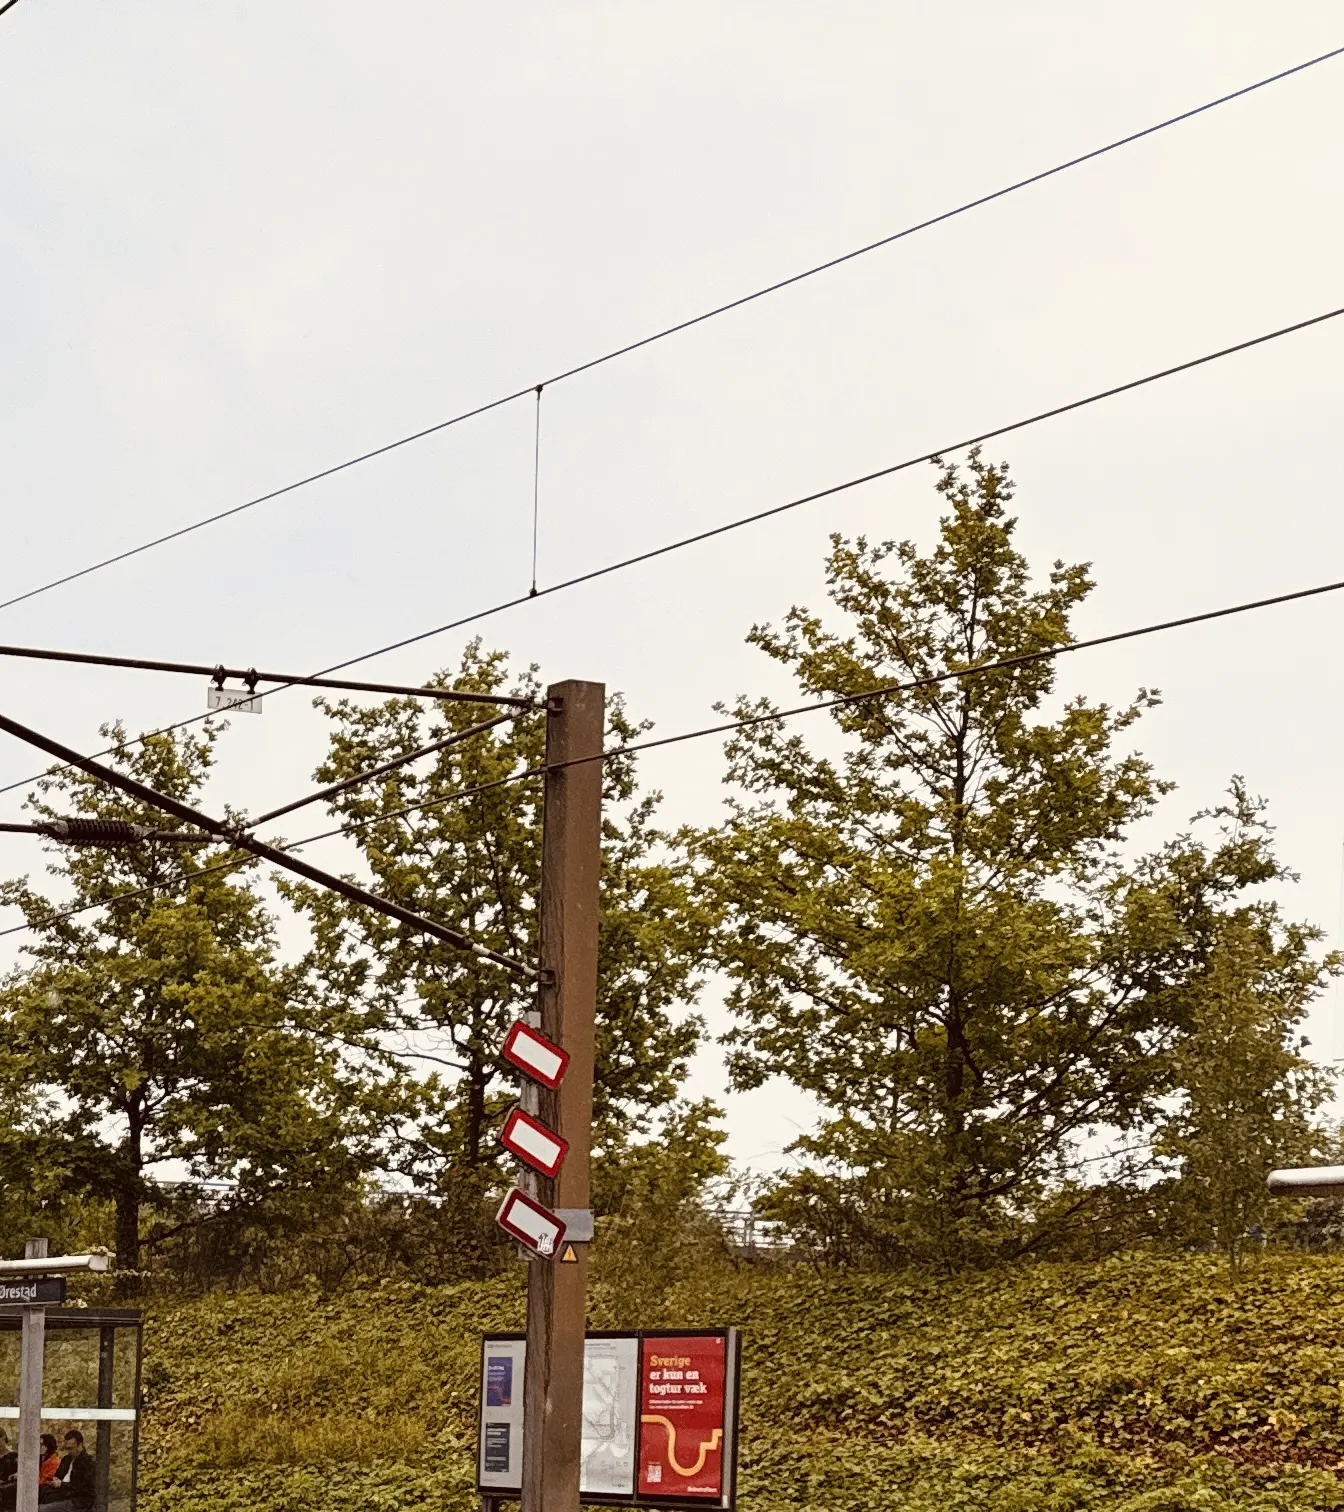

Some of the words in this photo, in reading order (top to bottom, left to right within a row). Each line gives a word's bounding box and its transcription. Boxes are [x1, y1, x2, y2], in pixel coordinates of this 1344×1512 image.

[650, 1355, 691, 1368] Sverige
[649, 1371, 660, 1380] er
[662, 1368, 683, 1380] kun
[686, 1370, 699, 1380] en
[649, 1382, 682, 1395] togtur
[684, 1381, 708, 1393] væk
